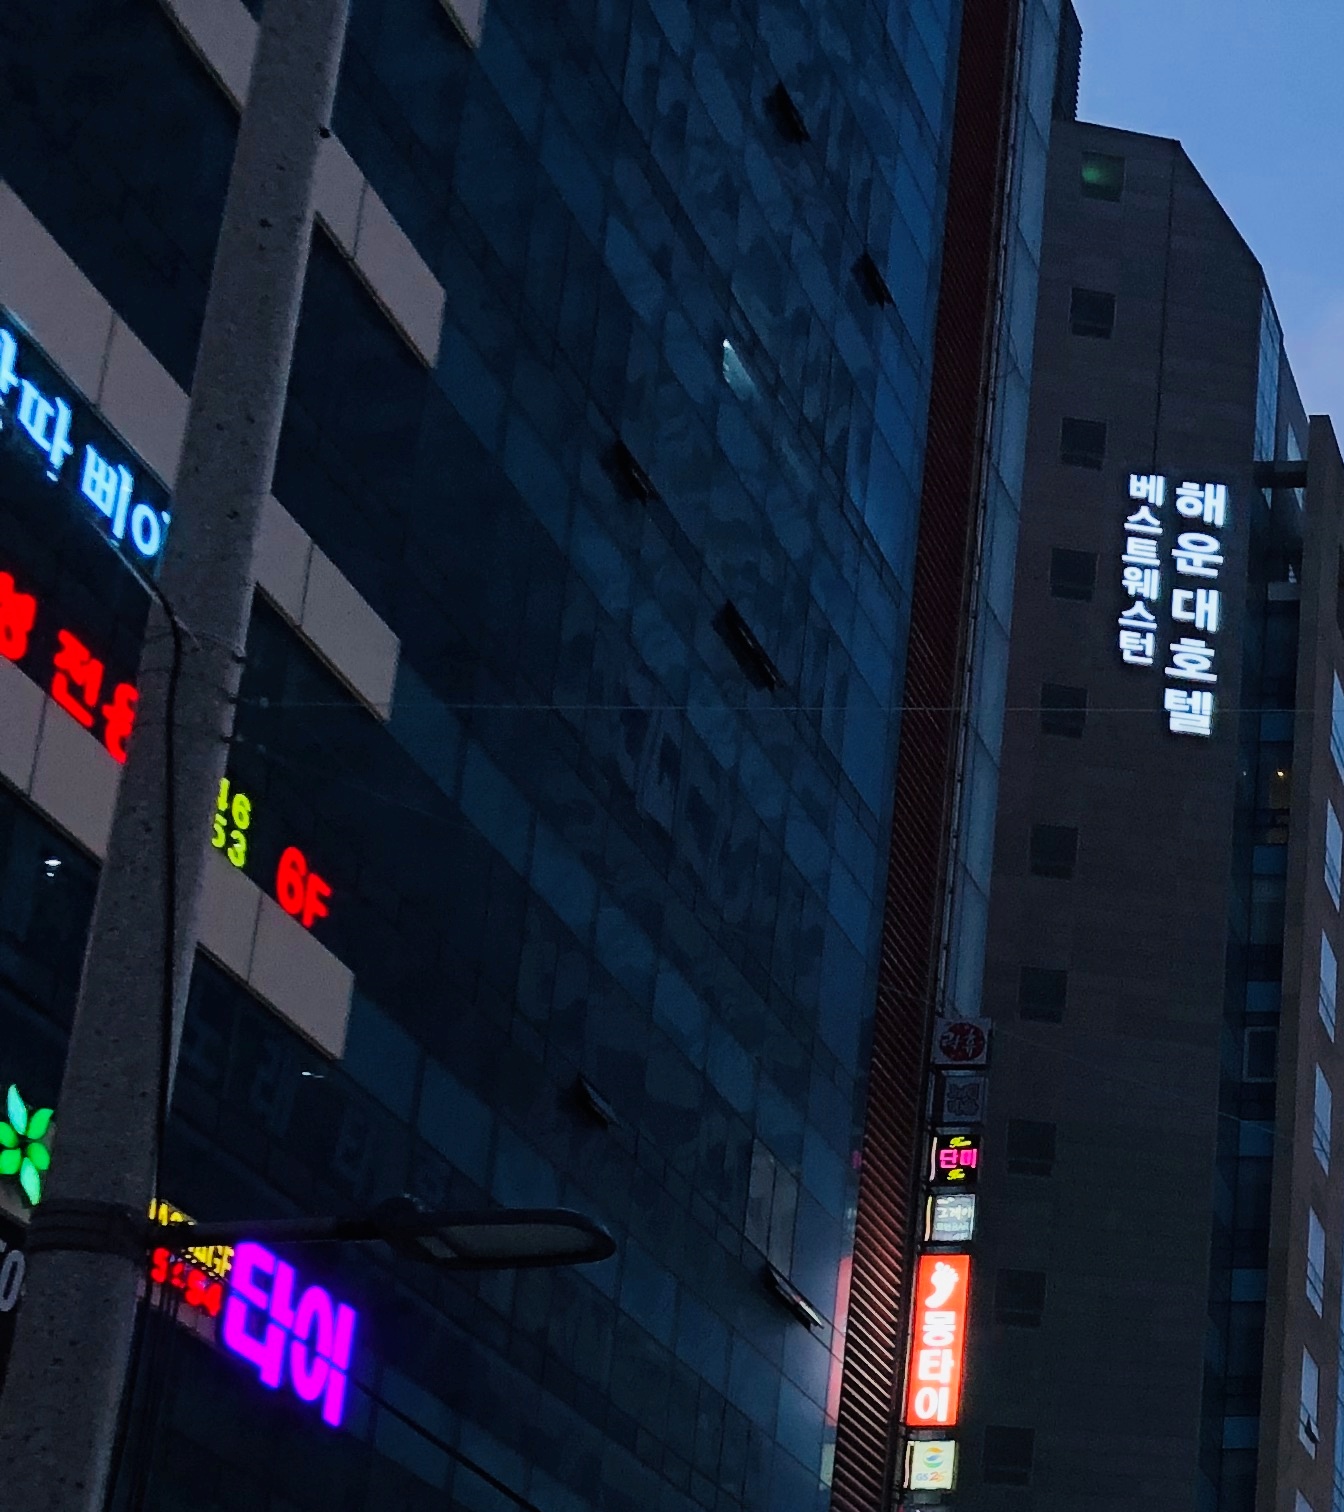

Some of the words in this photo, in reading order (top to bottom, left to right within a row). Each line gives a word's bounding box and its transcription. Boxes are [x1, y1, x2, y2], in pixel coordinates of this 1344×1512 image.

[1118, 473, 1167, 667] 베스트웨스턴
[1164, 481, 1229, 738] 해운대호텔
[276, 846, 333, 929] 6F
[915, 1471, 947, 1482] GS25
